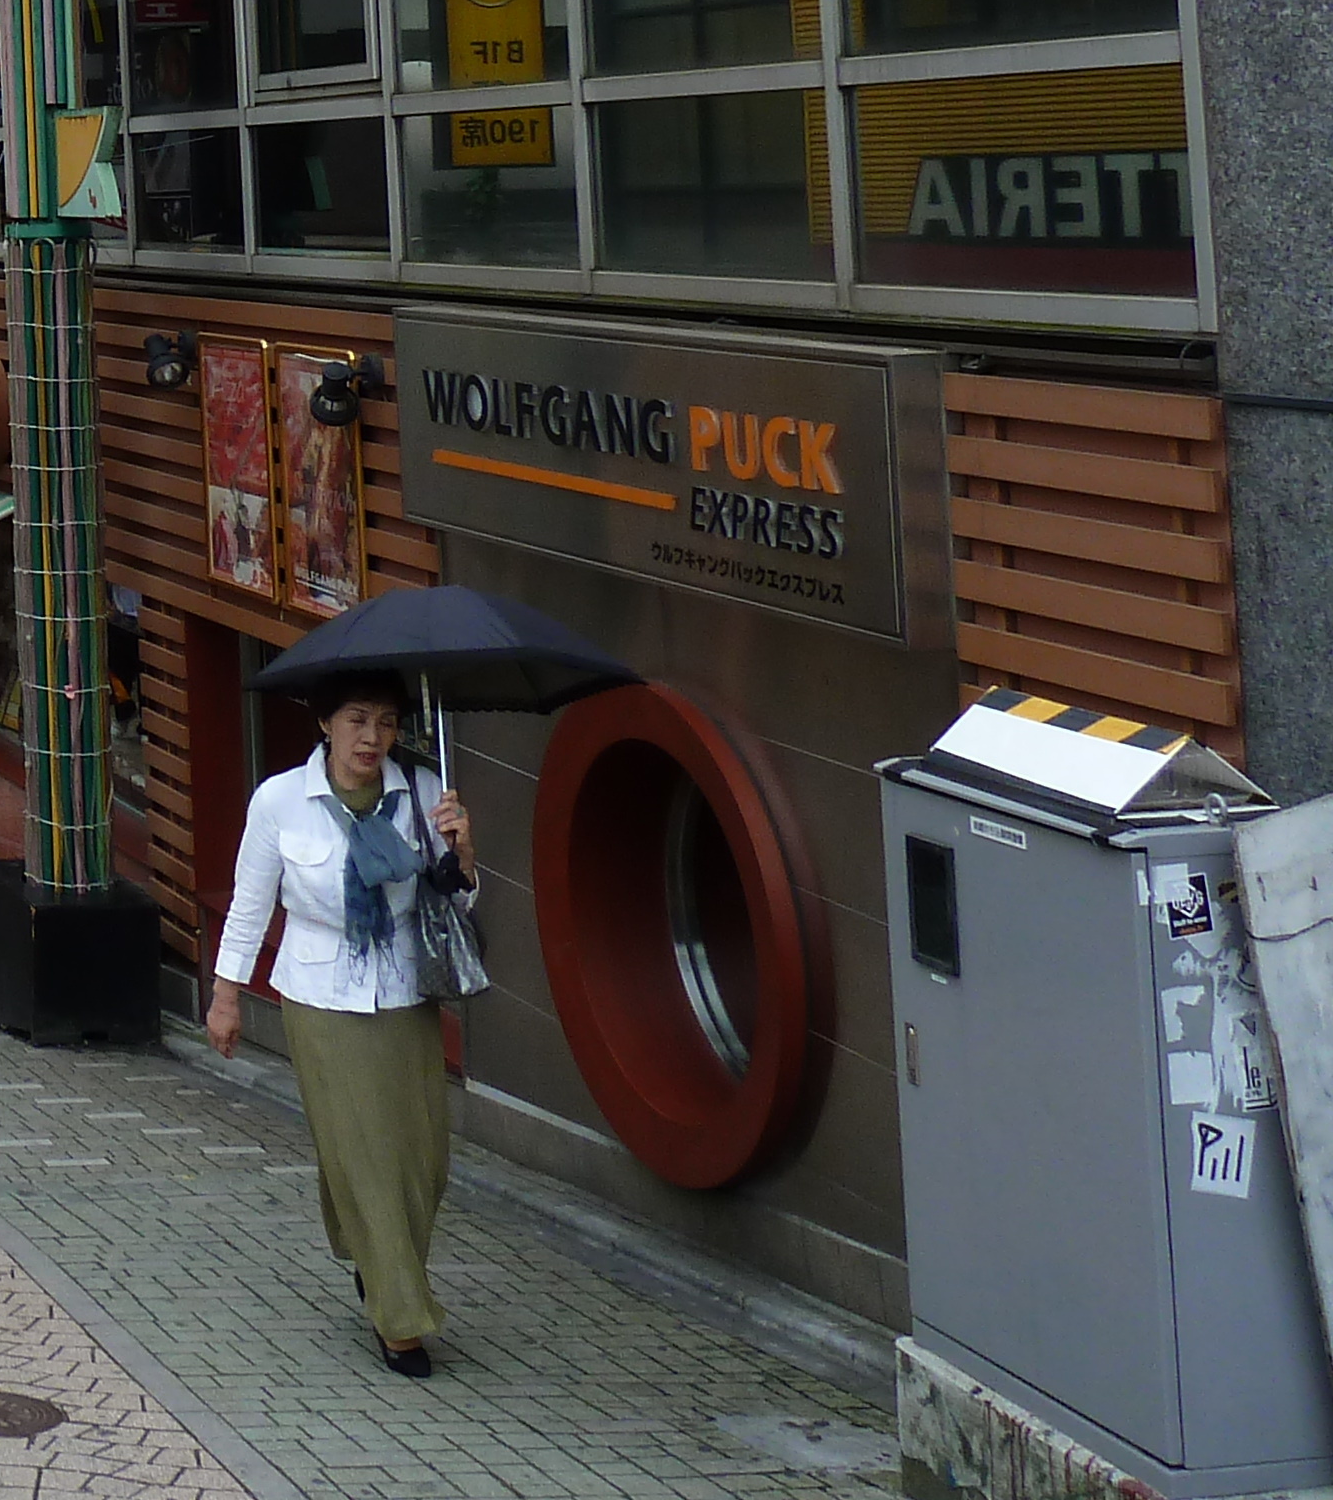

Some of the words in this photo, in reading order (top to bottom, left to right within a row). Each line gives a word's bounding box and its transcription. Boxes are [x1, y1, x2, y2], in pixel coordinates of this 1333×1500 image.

[422, 368, 678, 464] WOLFGANG
[689, 404, 845, 496] PUCK
[690, 485, 844, 561] EXPRESS
